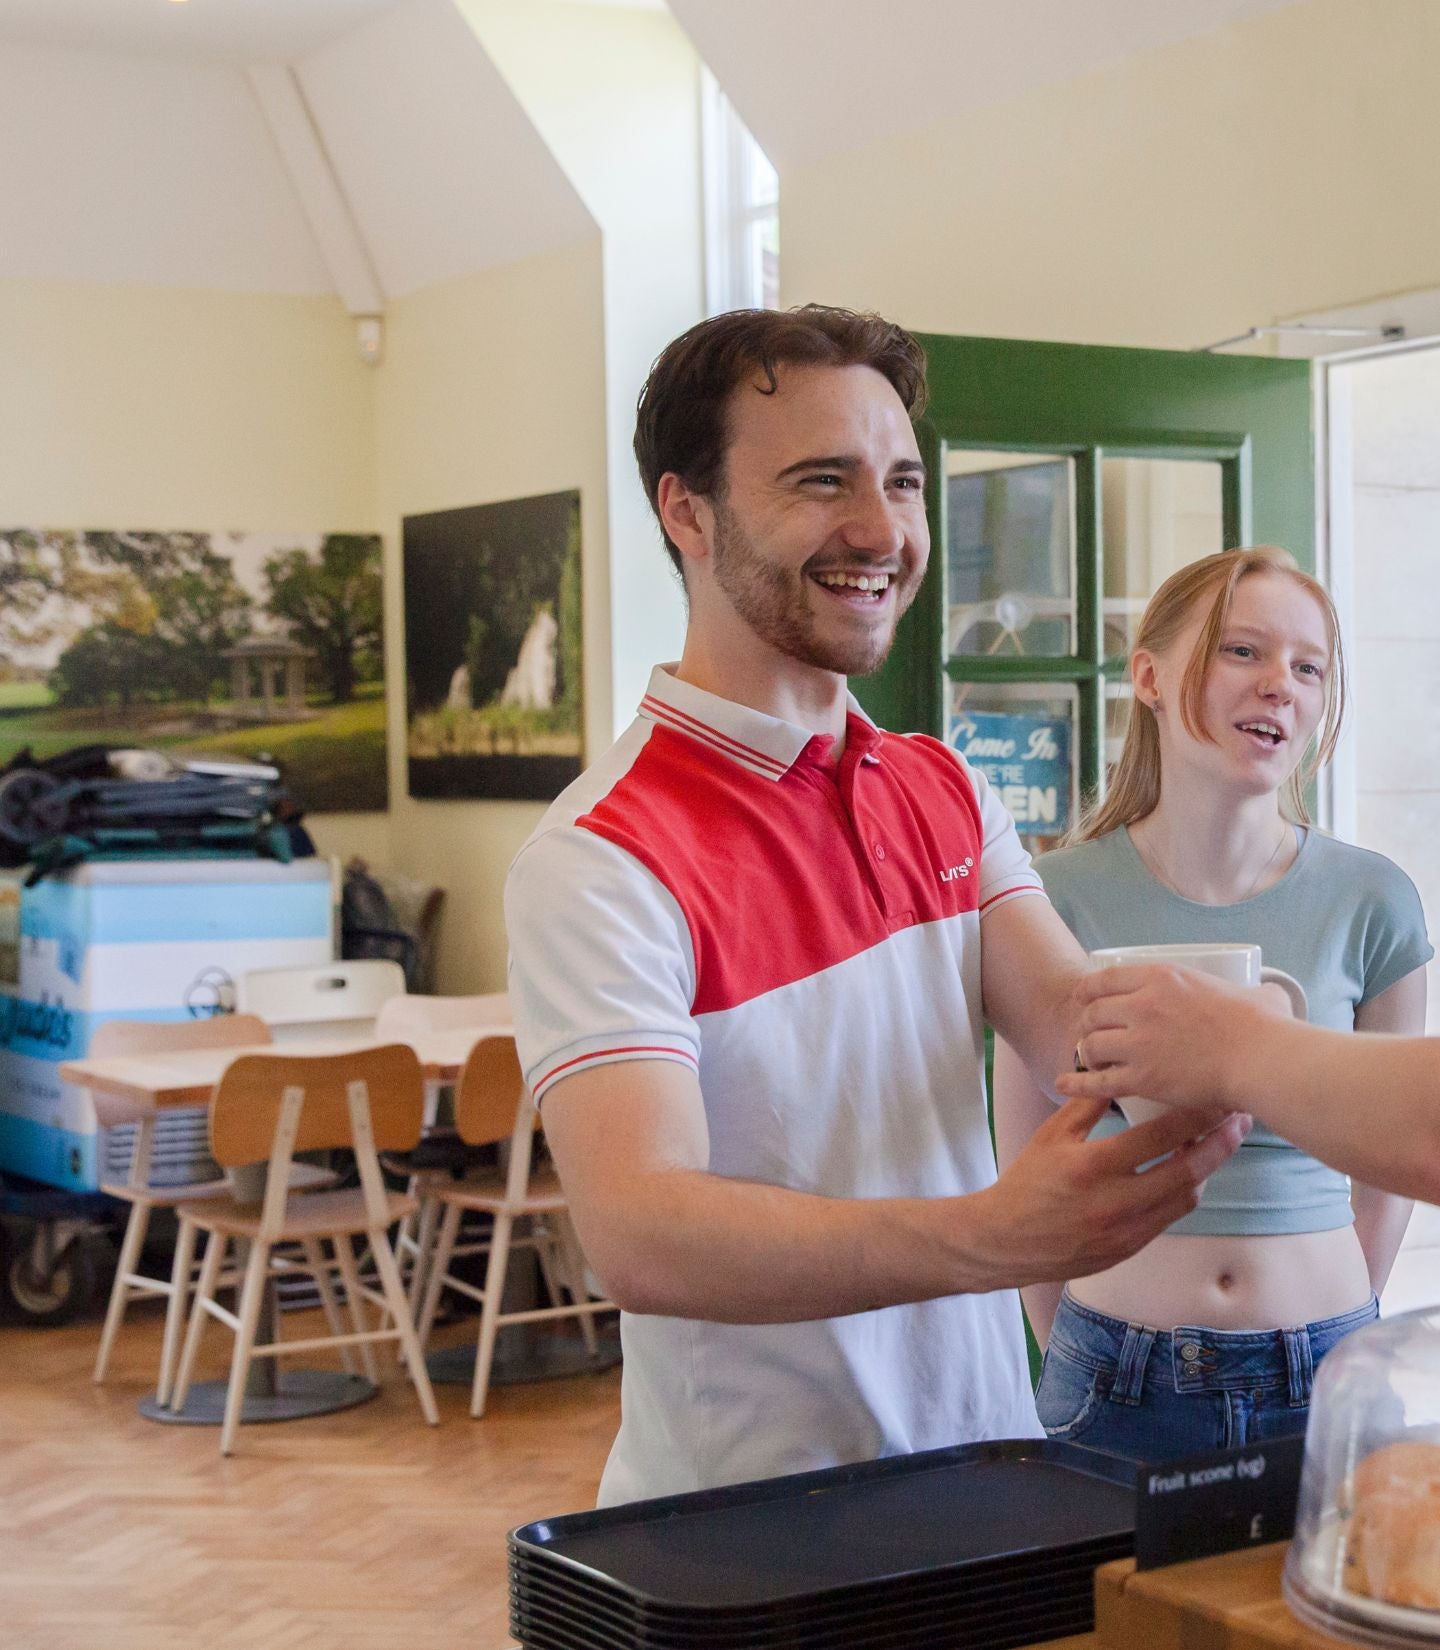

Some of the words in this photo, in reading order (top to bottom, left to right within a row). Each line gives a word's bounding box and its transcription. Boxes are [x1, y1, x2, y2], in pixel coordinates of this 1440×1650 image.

[1021, 727, 1058, 761] In
[989, 784, 1057, 823] EN
[1148, 1471, 1185, 1496] Fruit
[1189, 1464, 1235, 1487] scone
[1250, 1513, 1264, 1539] £
